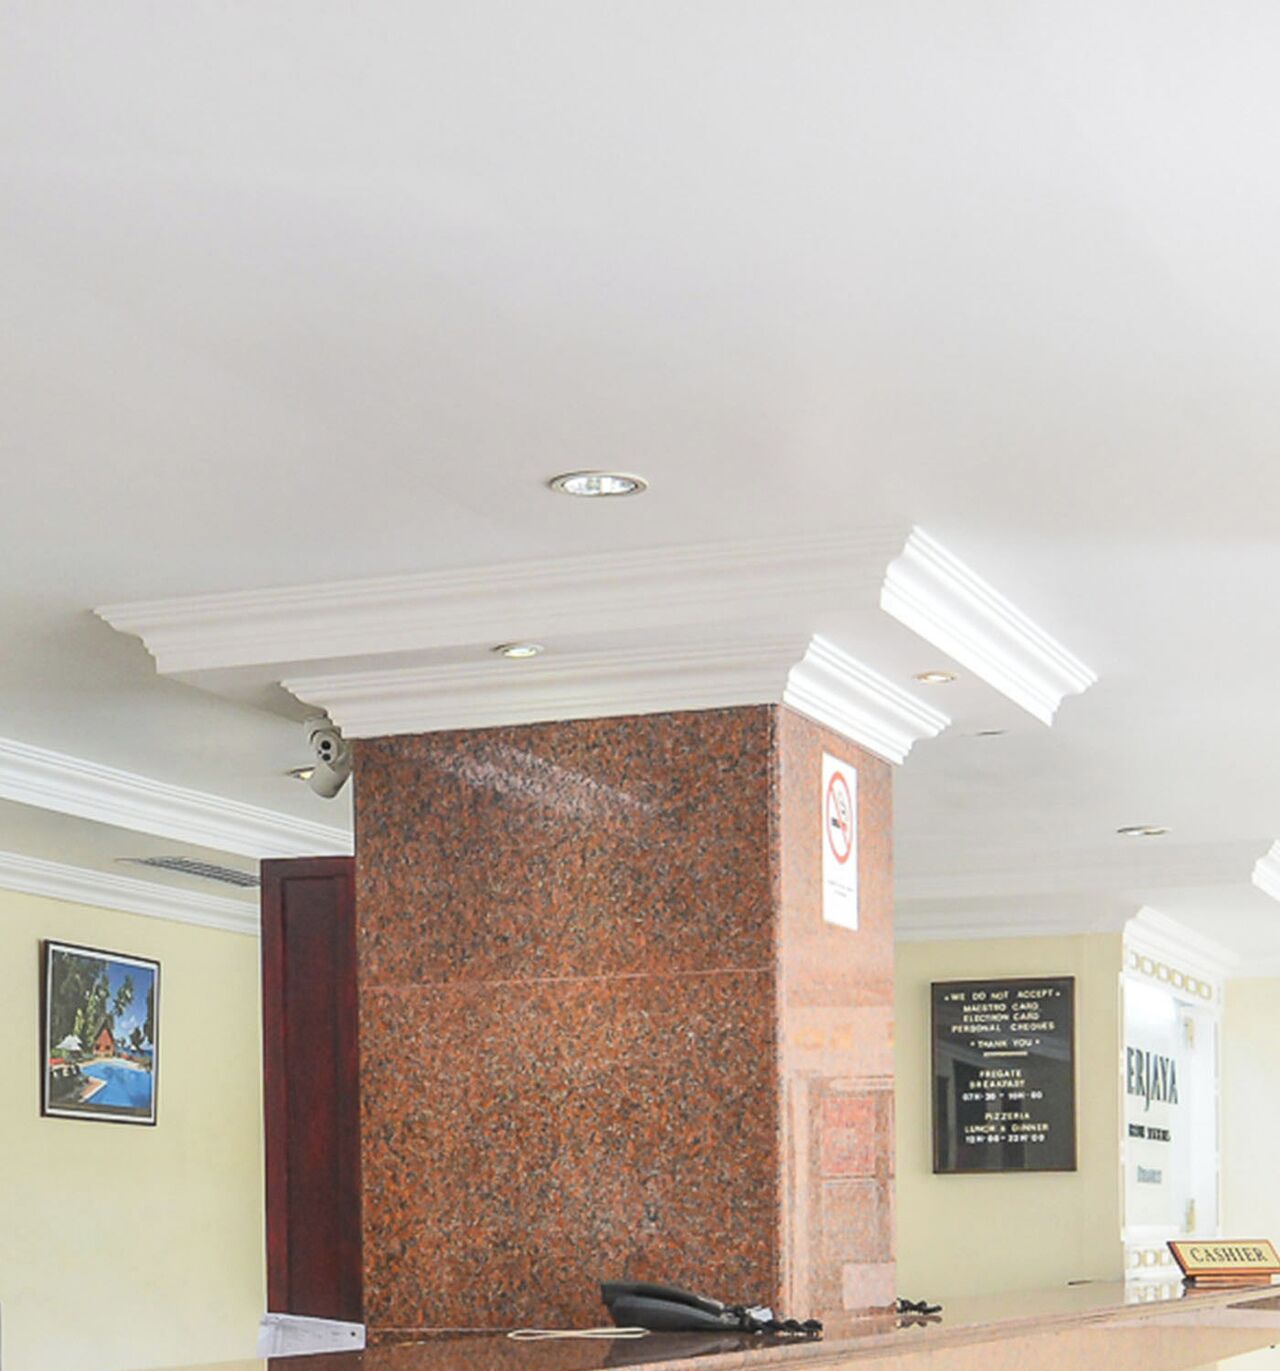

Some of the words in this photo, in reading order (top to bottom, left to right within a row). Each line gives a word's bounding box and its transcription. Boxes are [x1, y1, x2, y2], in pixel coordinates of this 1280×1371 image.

[951, 992, 965, 1001] WE
[972, 991, 986, 1000] DO
[991, 990, 1009, 1000] NOT
[1017, 988, 1054, 999] ACCEPT
[963, 1003, 1007, 1013] MAESTRO
[1011, 1002, 1039, 1011] CARD
[963, 1013, 1010, 1022] ELECTRON
[1012, 1012, 1040, 1021] CARD
[951, 1023, 1001, 1033] PERSONAL
[1010, 1021, 1056, 1031] CHEQUES
[977, 1039, 1008, 1048] THANK
[1012, 1038, 1033, 1047] YOU
[969, 1079, 1026, 1089] BREAKFAST
[984, 1112, 1030, 1121] PIZZERIA
[964, 1125, 996, 1134] LUNCH
[1011, 1123, 1049, 1132] DINNER
[1189, 1246, 1268, 1263] CASHIER
